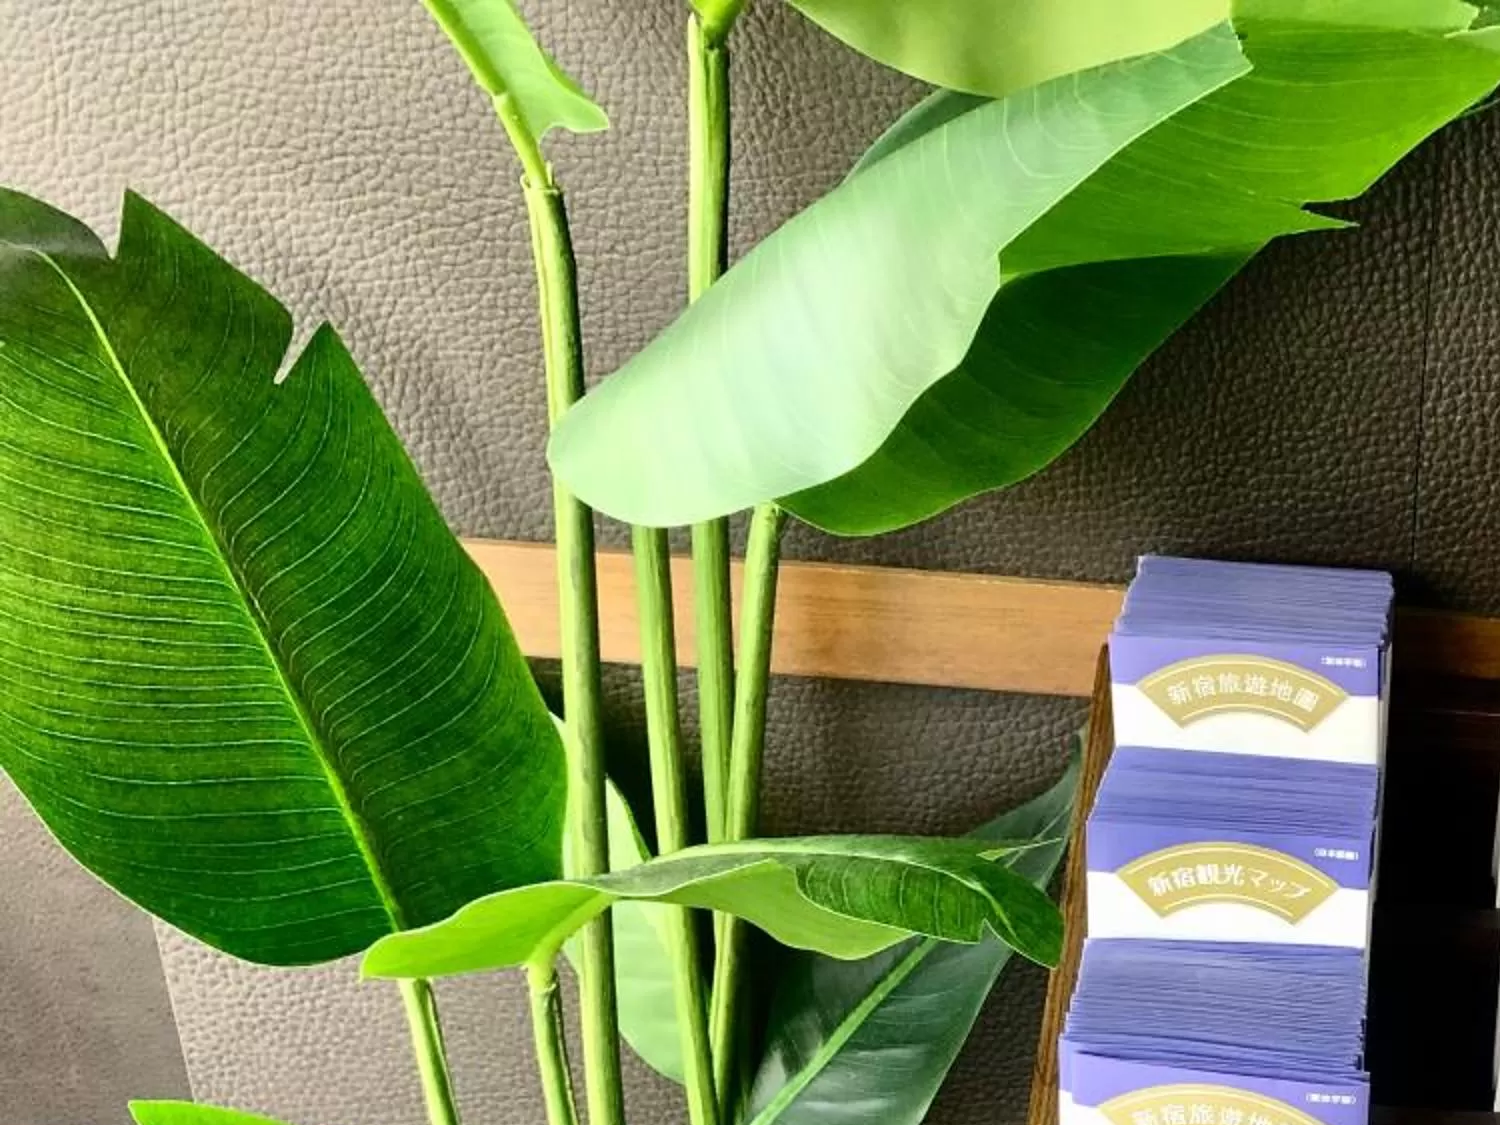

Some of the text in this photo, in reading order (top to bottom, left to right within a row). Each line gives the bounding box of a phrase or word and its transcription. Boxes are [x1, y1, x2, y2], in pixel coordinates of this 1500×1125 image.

[1147, 863, 1312, 900] 新宿観光マップ
